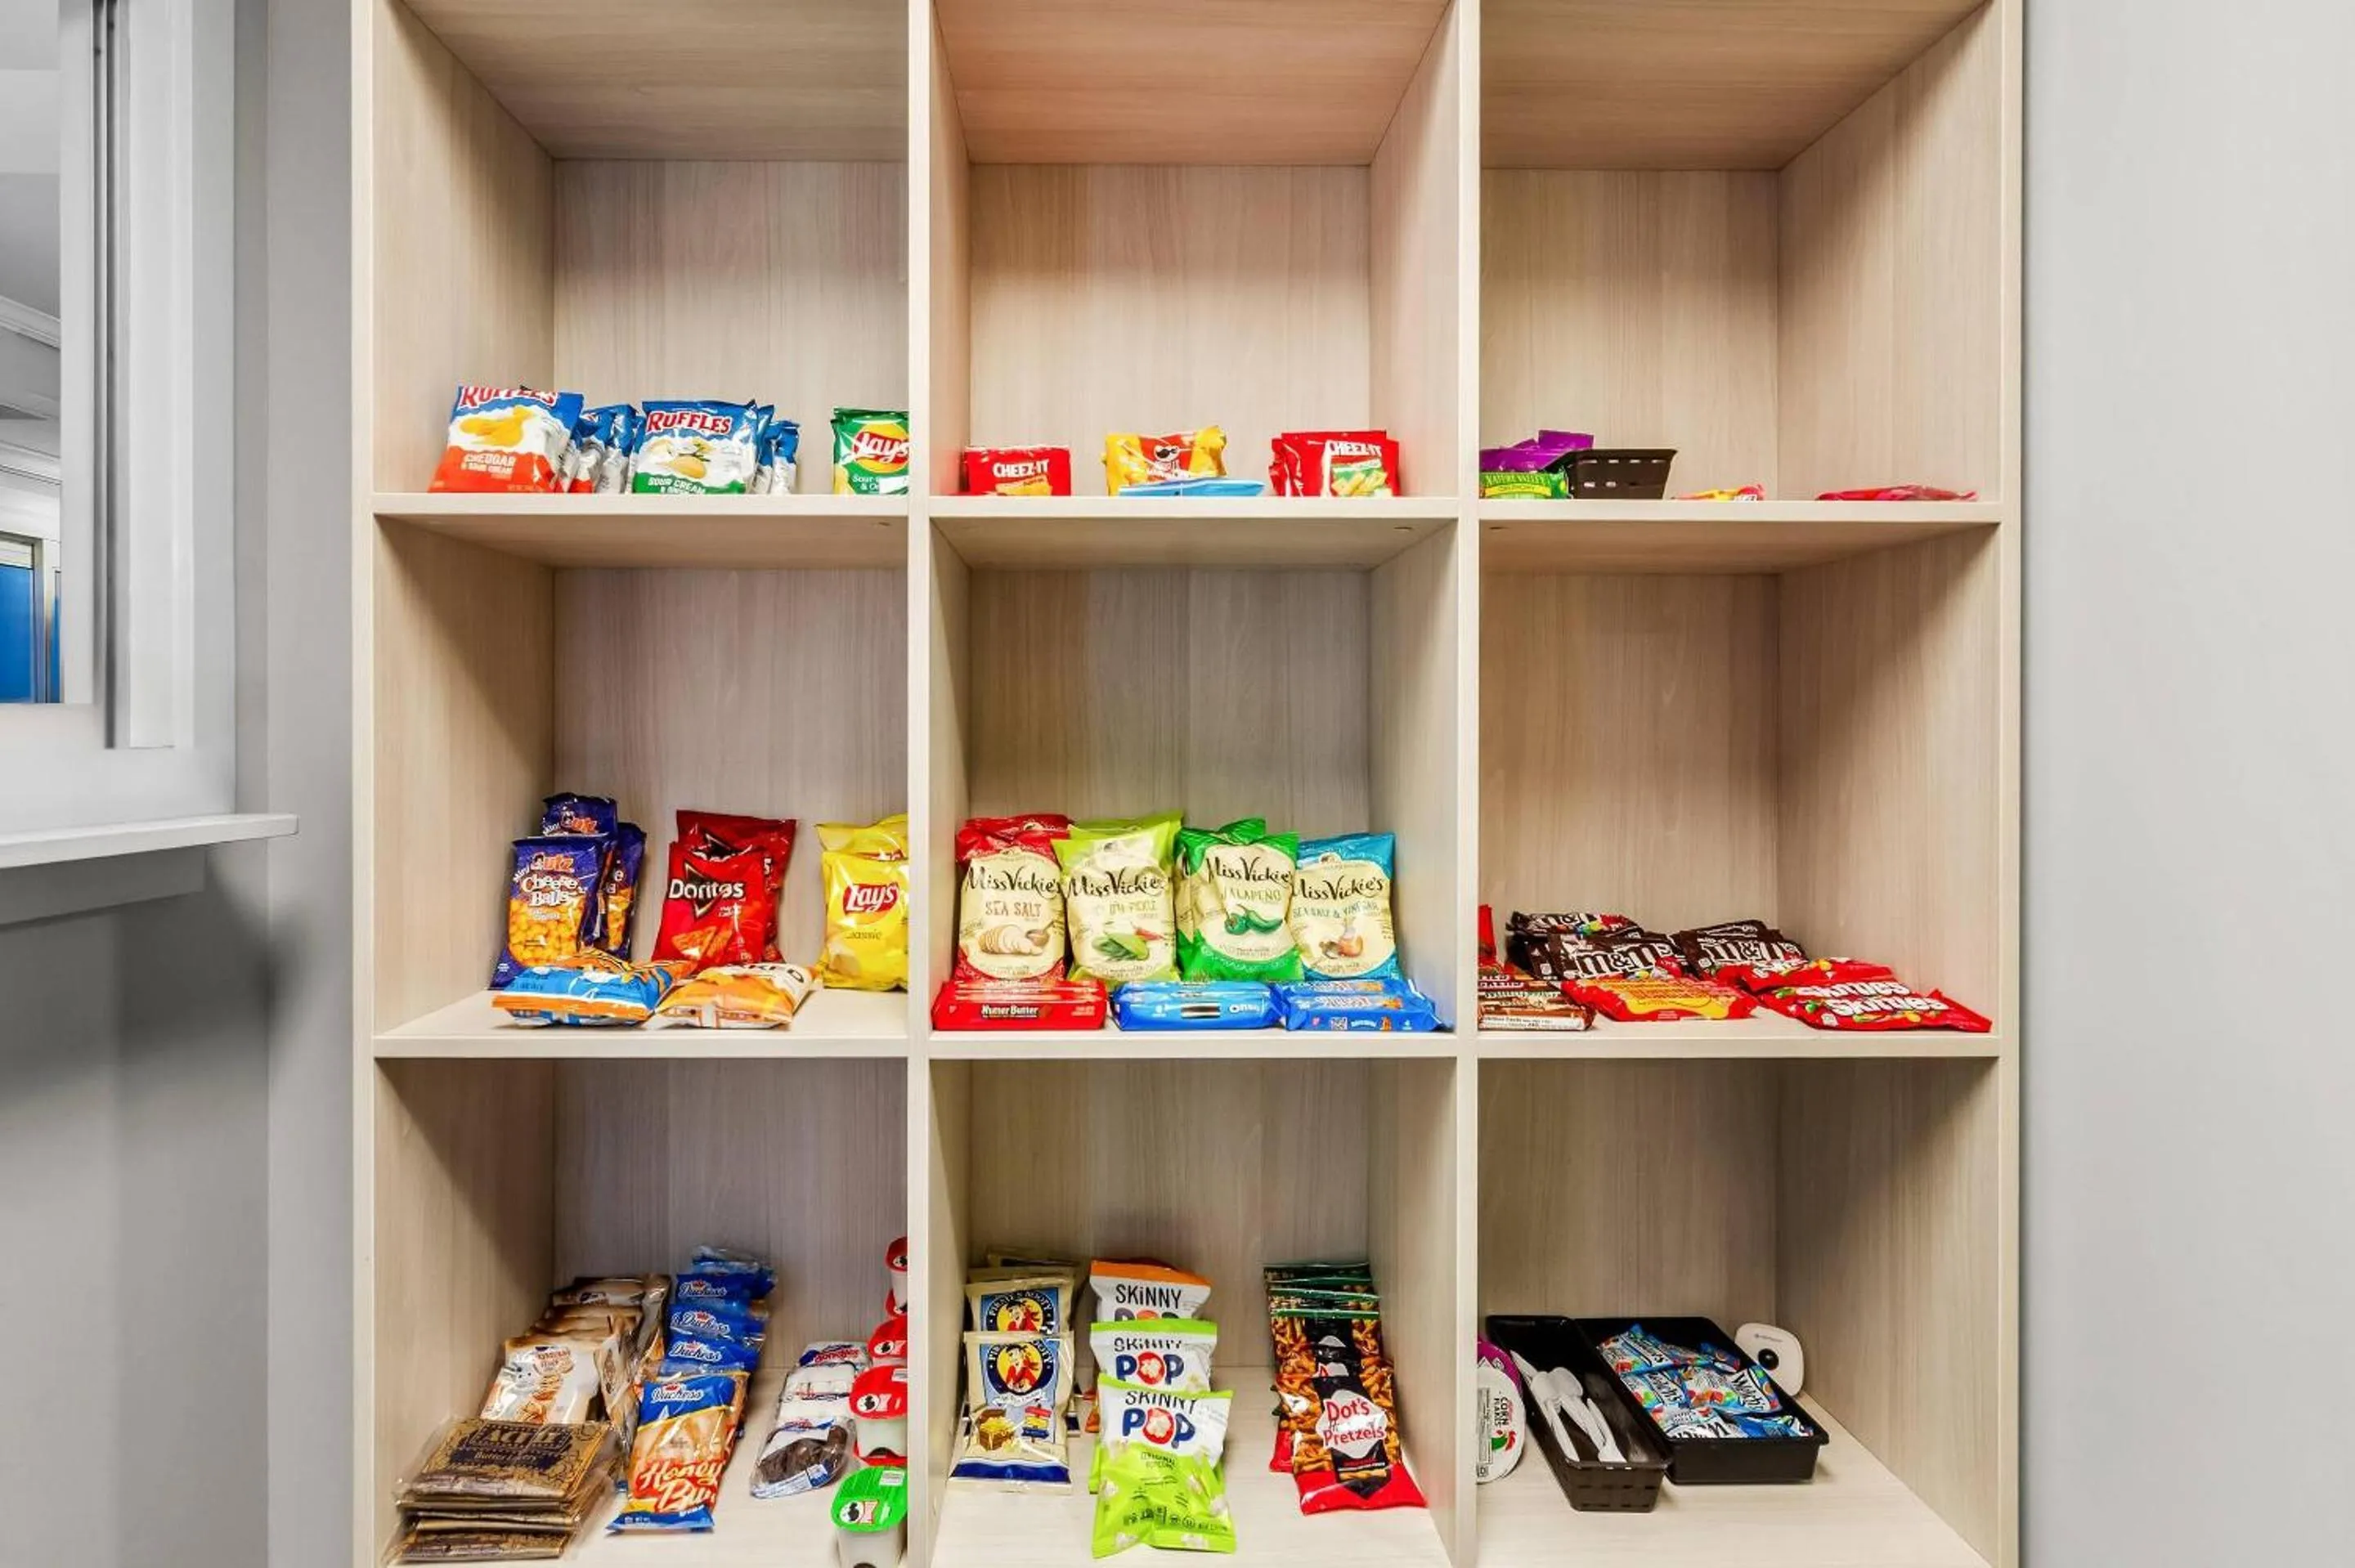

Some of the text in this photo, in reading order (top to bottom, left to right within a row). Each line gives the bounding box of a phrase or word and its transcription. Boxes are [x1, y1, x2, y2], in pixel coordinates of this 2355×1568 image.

[647, 411, 732, 434] RUFFLES
[992, 458, 1050, 478] CHEEZ-IT
[1206, 857, 1242, 883] Miss
[522, 874, 579, 892] Cheese
[668, 879, 745, 899] Doritos
[964, 866, 1062, 900] Miss Vickie's
[1066, 873, 1110, 898] Miss
[1322, 876, 1384, 899] Vickie's
[528, 889, 572, 907] Balls
[985, 900, 1042, 917] SEA SALT
[1826, 997, 1949, 1016] Skittles
[1115, 1351, 1185, 1385] POP
[1326, 1398, 1370, 1422] Dot's
[1122, 1407, 1195, 1449] POP
[1323, 1426, 1385, 1446] Pretzels
[639, 1460, 724, 1492] Honey
